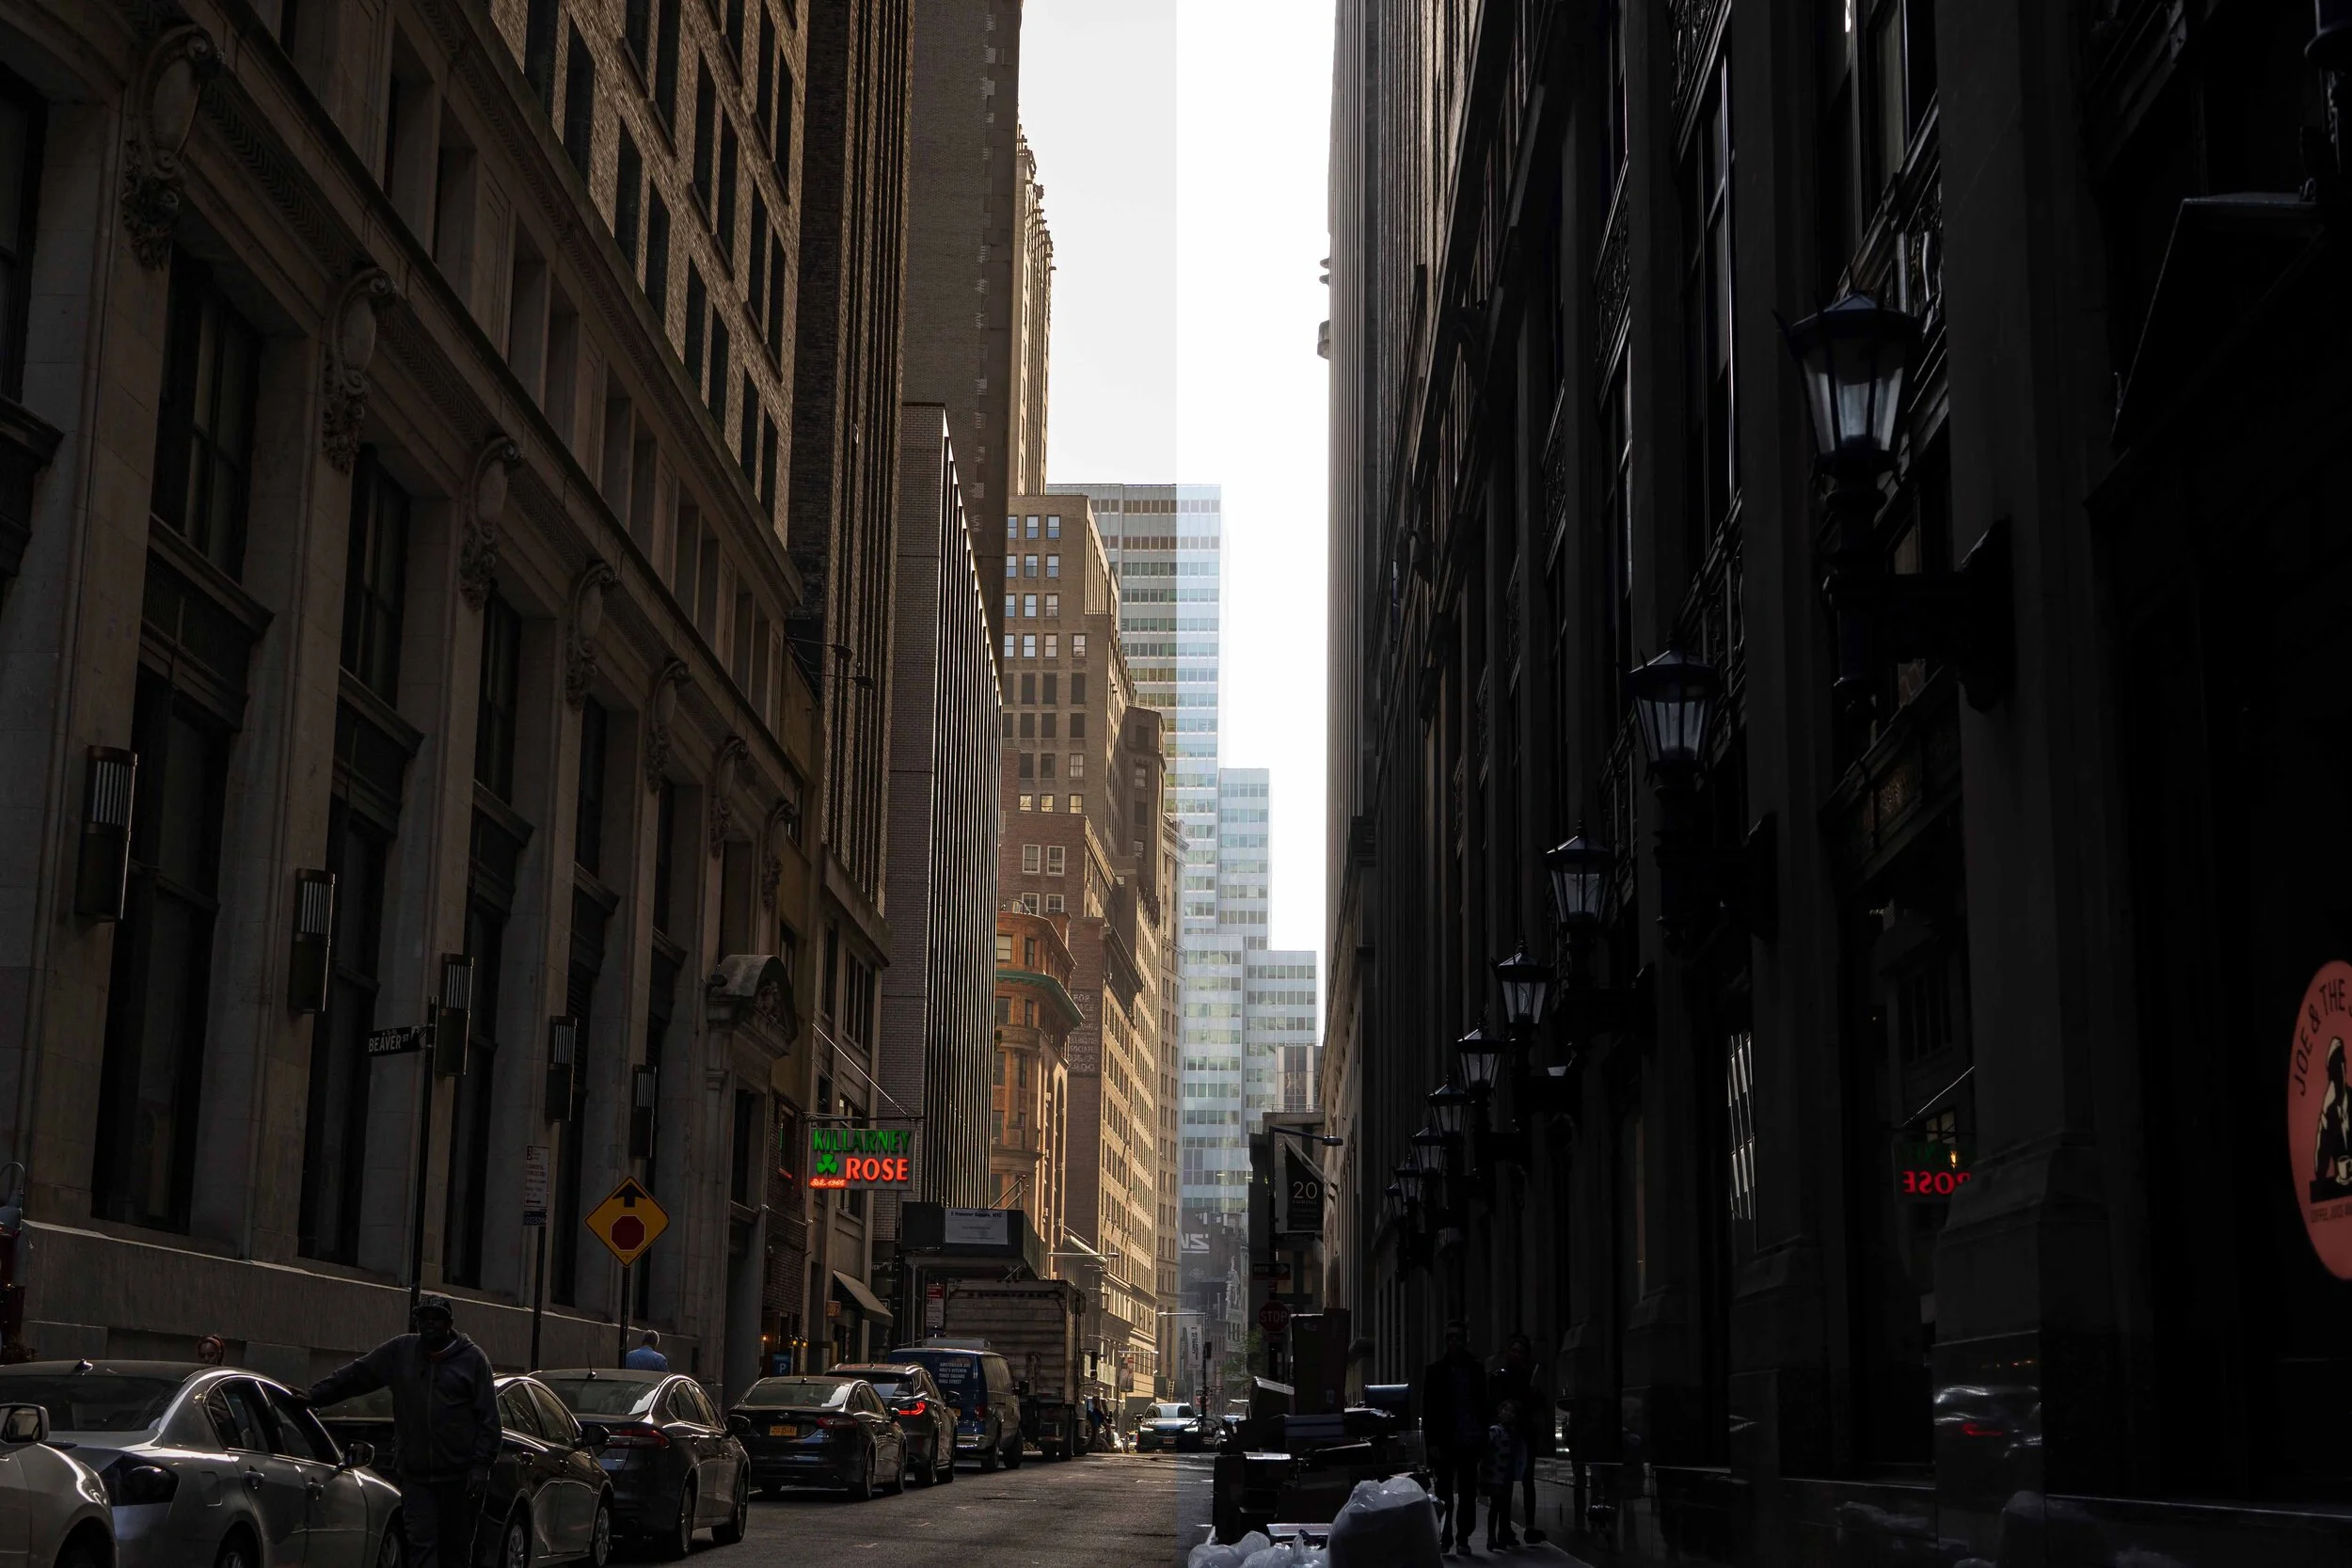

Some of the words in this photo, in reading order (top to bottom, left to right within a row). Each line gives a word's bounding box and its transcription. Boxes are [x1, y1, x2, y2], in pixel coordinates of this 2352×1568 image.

[369, 1035, 402, 1053] BEAVER
[403, 1034, 409, 1042] ST
[2295, 1027, 2312, 1096] JOE
[2309, 1004, 2321, 1034] &
[2319, 978, 2345, 1016] THE
[813, 1129, 911, 1153] KILLARNEY
[845, 1157, 910, 1182] ROSE
[1293, 1181, 1318, 1199] 20
[1261, 1311, 1288, 1323] STOP
[779, 1363, 787, 1373] P
